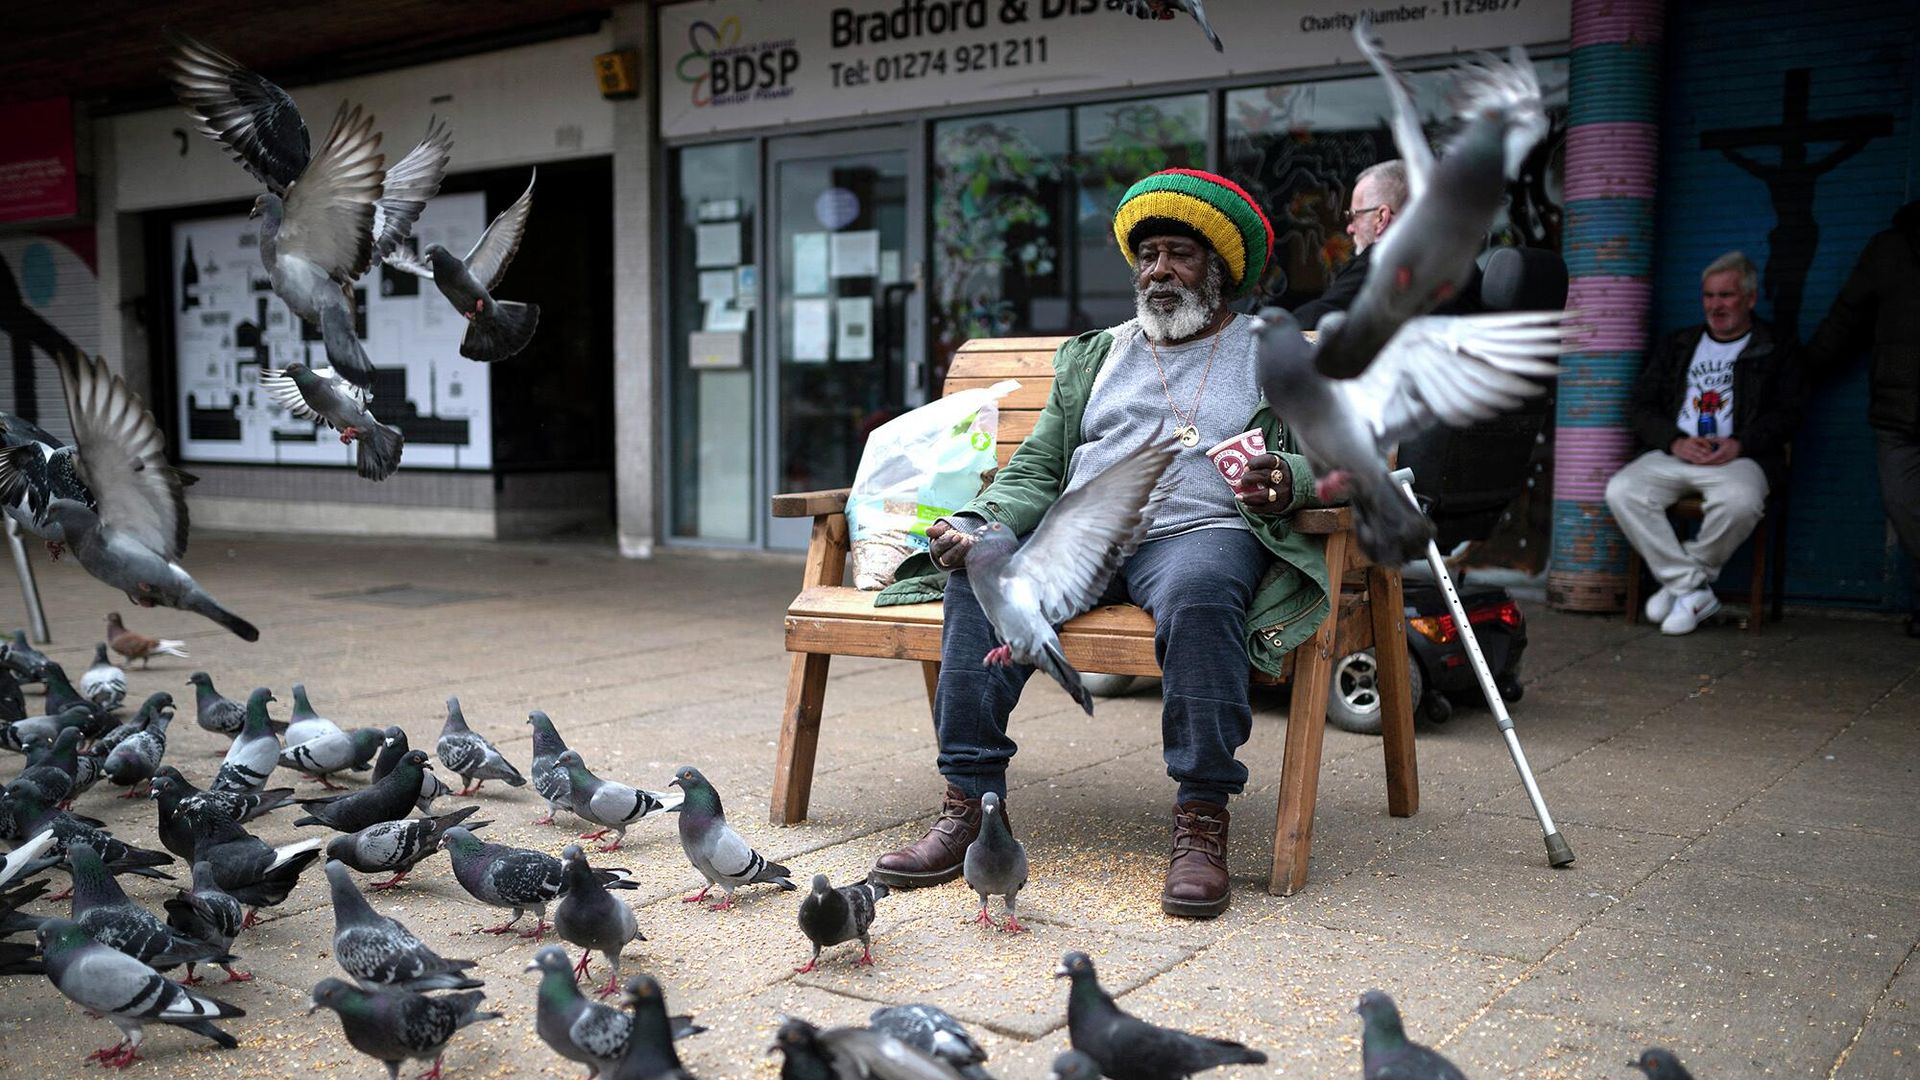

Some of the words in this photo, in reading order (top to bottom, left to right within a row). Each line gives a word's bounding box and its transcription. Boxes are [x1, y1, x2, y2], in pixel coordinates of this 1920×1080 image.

[830, 0, 987, 48] Bradford
[1000, 0, 1030, 26] &
[1300, 11, 1357, 32] Charity
[711, 48, 799, 96] BDSP
[830, 60, 870, 88] Tel:
[875, 48, 947, 82] 01274
[954, 36, 1049, 73] 921211
